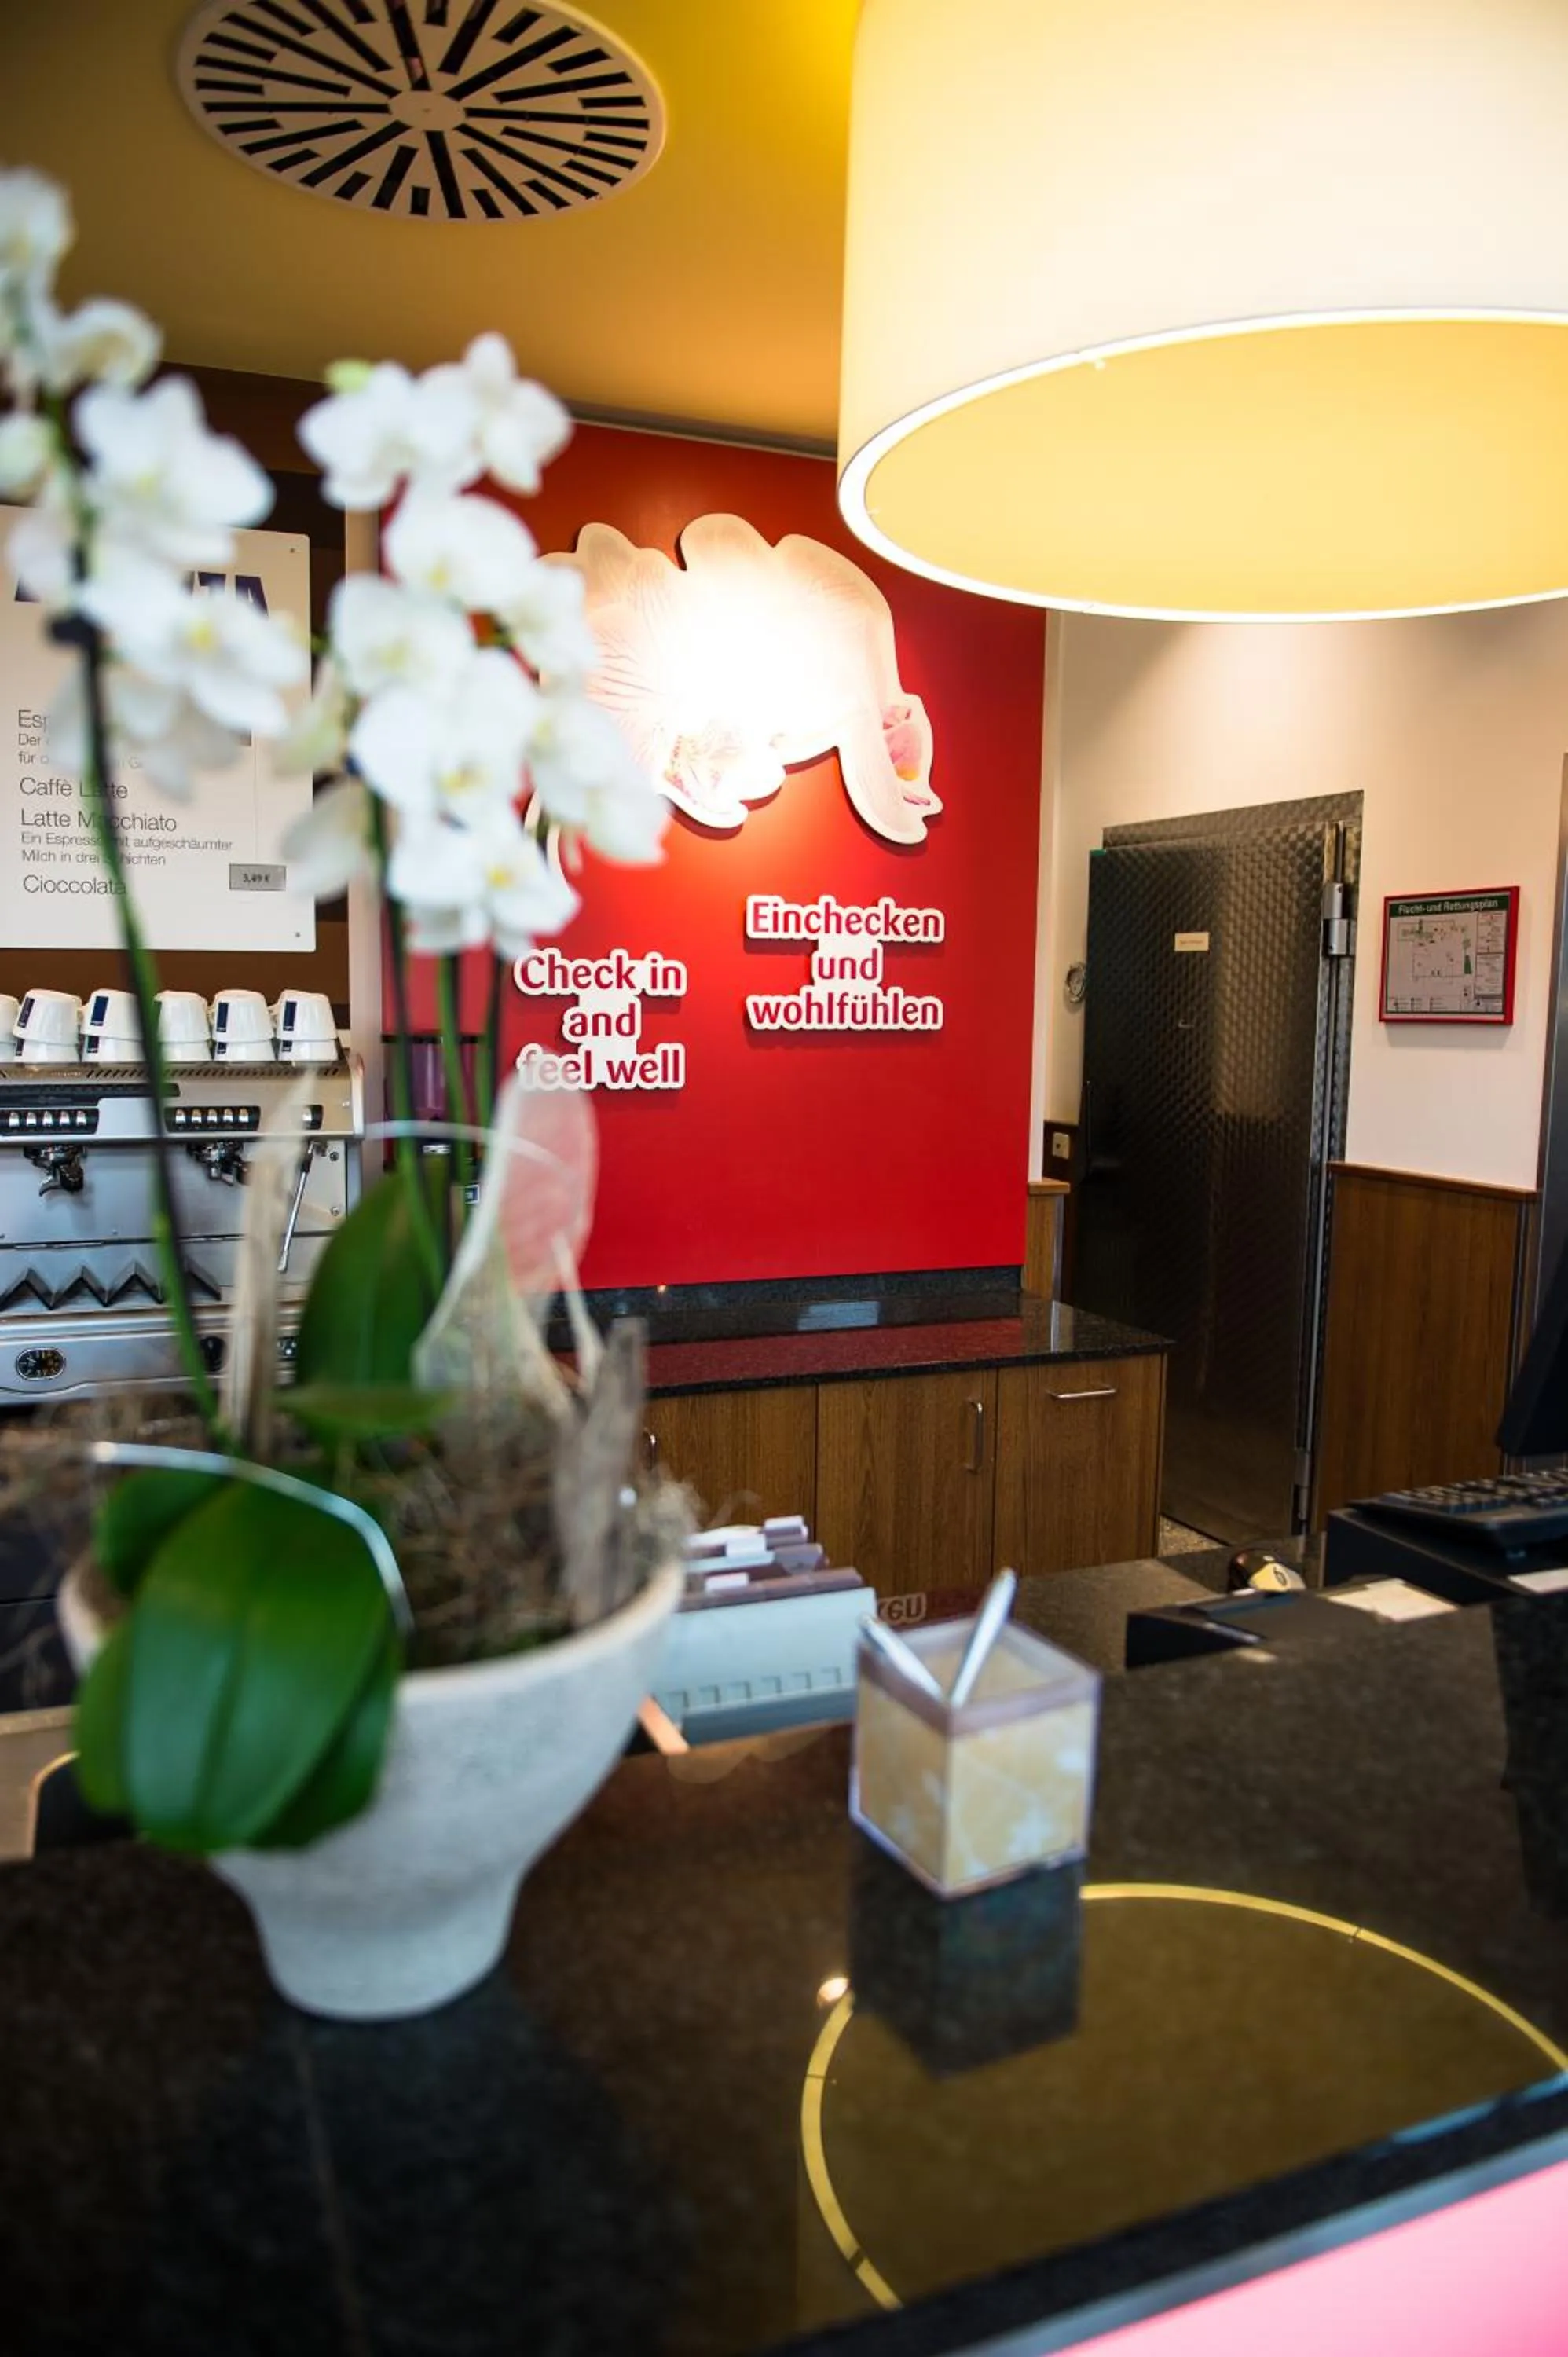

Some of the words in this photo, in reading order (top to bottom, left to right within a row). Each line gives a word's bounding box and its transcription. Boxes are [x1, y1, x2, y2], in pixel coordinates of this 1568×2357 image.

[18, 733, 41, 746] Der
[18, 750, 35, 764] für
[20, 776, 72, 797] Caffè
[21, 808, 71, 827] Latte
[79, 810, 177, 832] Mcchiato
[46, 833, 103, 848] Espress
[22, 849, 56, 863] Milch
[60, 850, 71, 863] in
[23, 874, 127, 895] Cioccolata
[752, 901, 940, 937] Einchecken
[520, 954, 636, 991] Check
[650, 955, 682, 990] in
[818, 948, 879, 981] und
[567, 1003, 636, 1037] and
[752, 992, 940, 1025] wohlfühlen
[522, 1049, 592, 1085] feel
[606, 1049, 680, 1084] well
